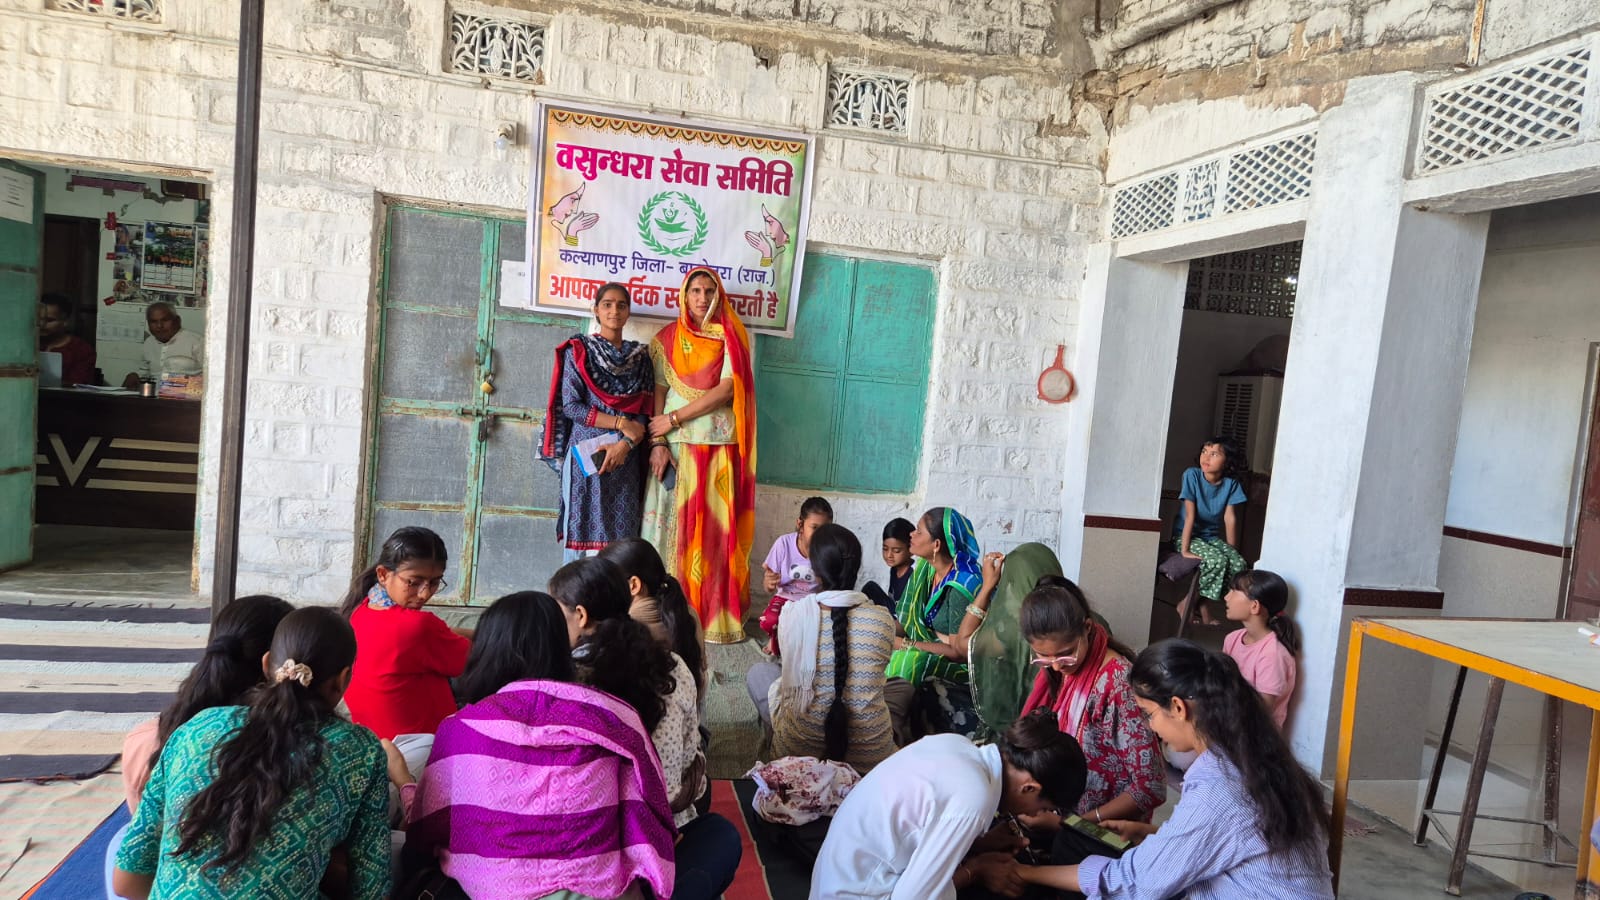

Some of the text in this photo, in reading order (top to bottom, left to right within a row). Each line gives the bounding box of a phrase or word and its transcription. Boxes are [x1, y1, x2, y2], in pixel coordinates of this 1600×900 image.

[556, 144, 793, 196] वसुन्धरा सेवा समिति
[559, 249, 626, 273] कल्याणपुर
[632, 253, 674, 273] जिला-
[738, 265, 775, 287] (राज.)
[767, 290, 779, 319] है
